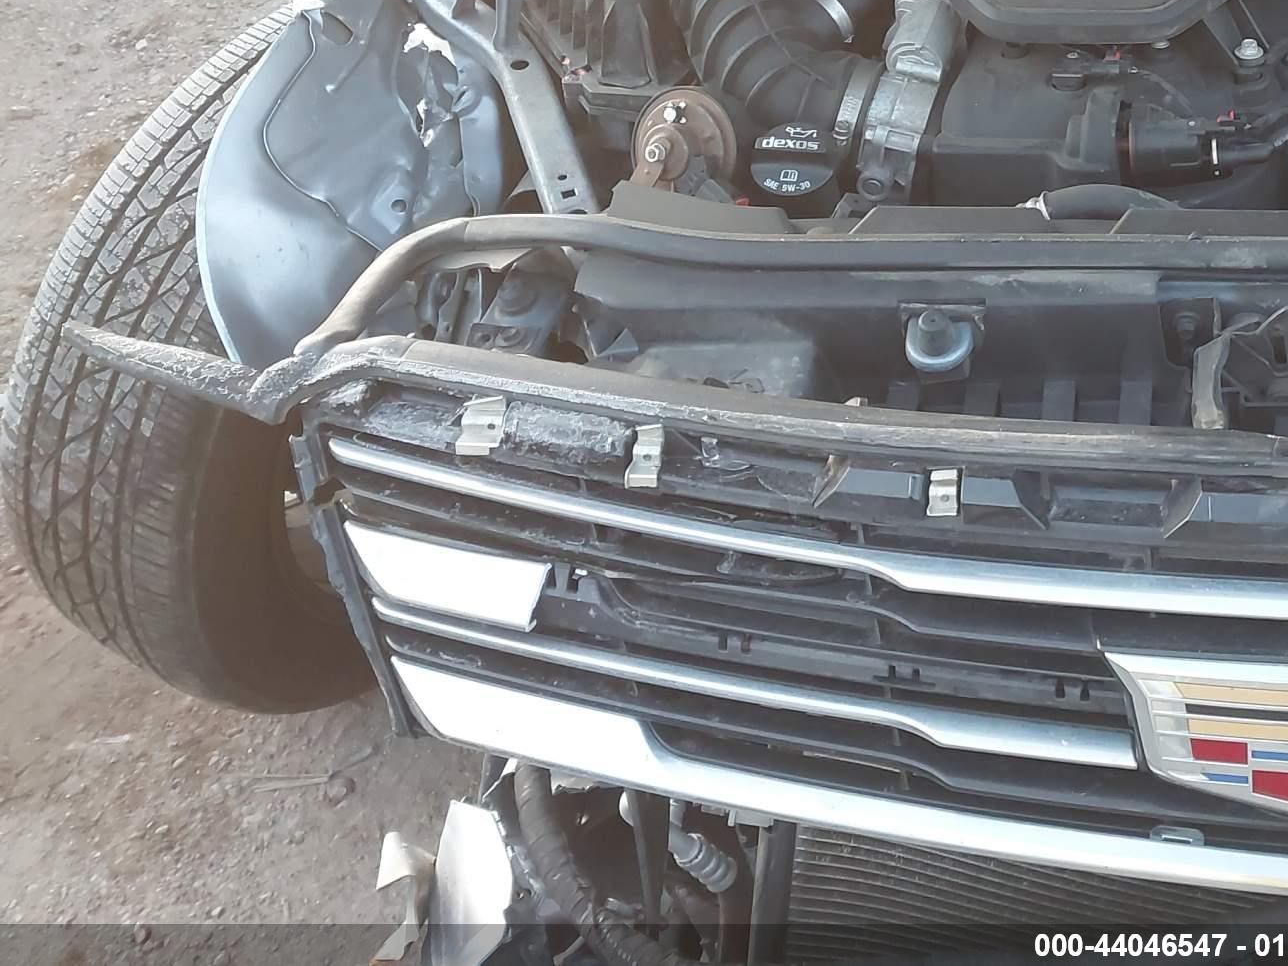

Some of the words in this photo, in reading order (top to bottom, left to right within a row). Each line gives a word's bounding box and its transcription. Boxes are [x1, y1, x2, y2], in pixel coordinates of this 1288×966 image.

[761, 136, 820, 150] dexos
[764, 178, 780, 190] SAE
[781, 181, 811, 192] 5W-30
